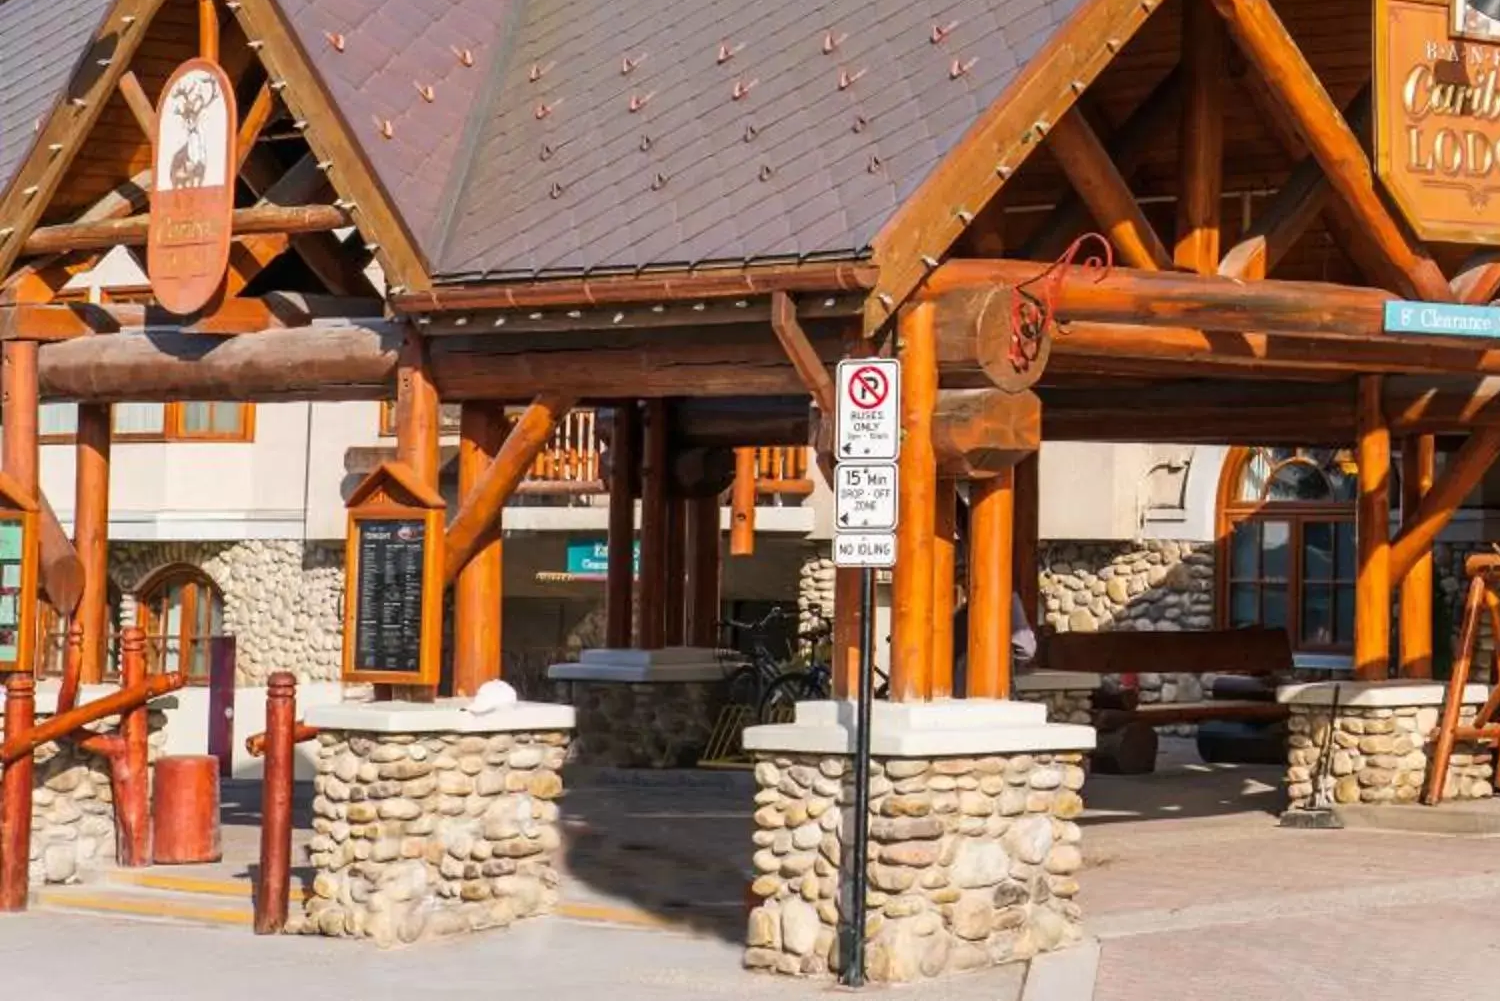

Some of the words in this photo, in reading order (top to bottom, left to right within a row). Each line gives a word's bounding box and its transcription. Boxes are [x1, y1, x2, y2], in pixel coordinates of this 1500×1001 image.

[1420, 308, 1492, 331] Clearance
[853, 422, 880, 431] ONLY
[846, 470, 861, 486] 15
[839, 543, 854, 555] NO
[857, 542, 891, 556] IDLING
